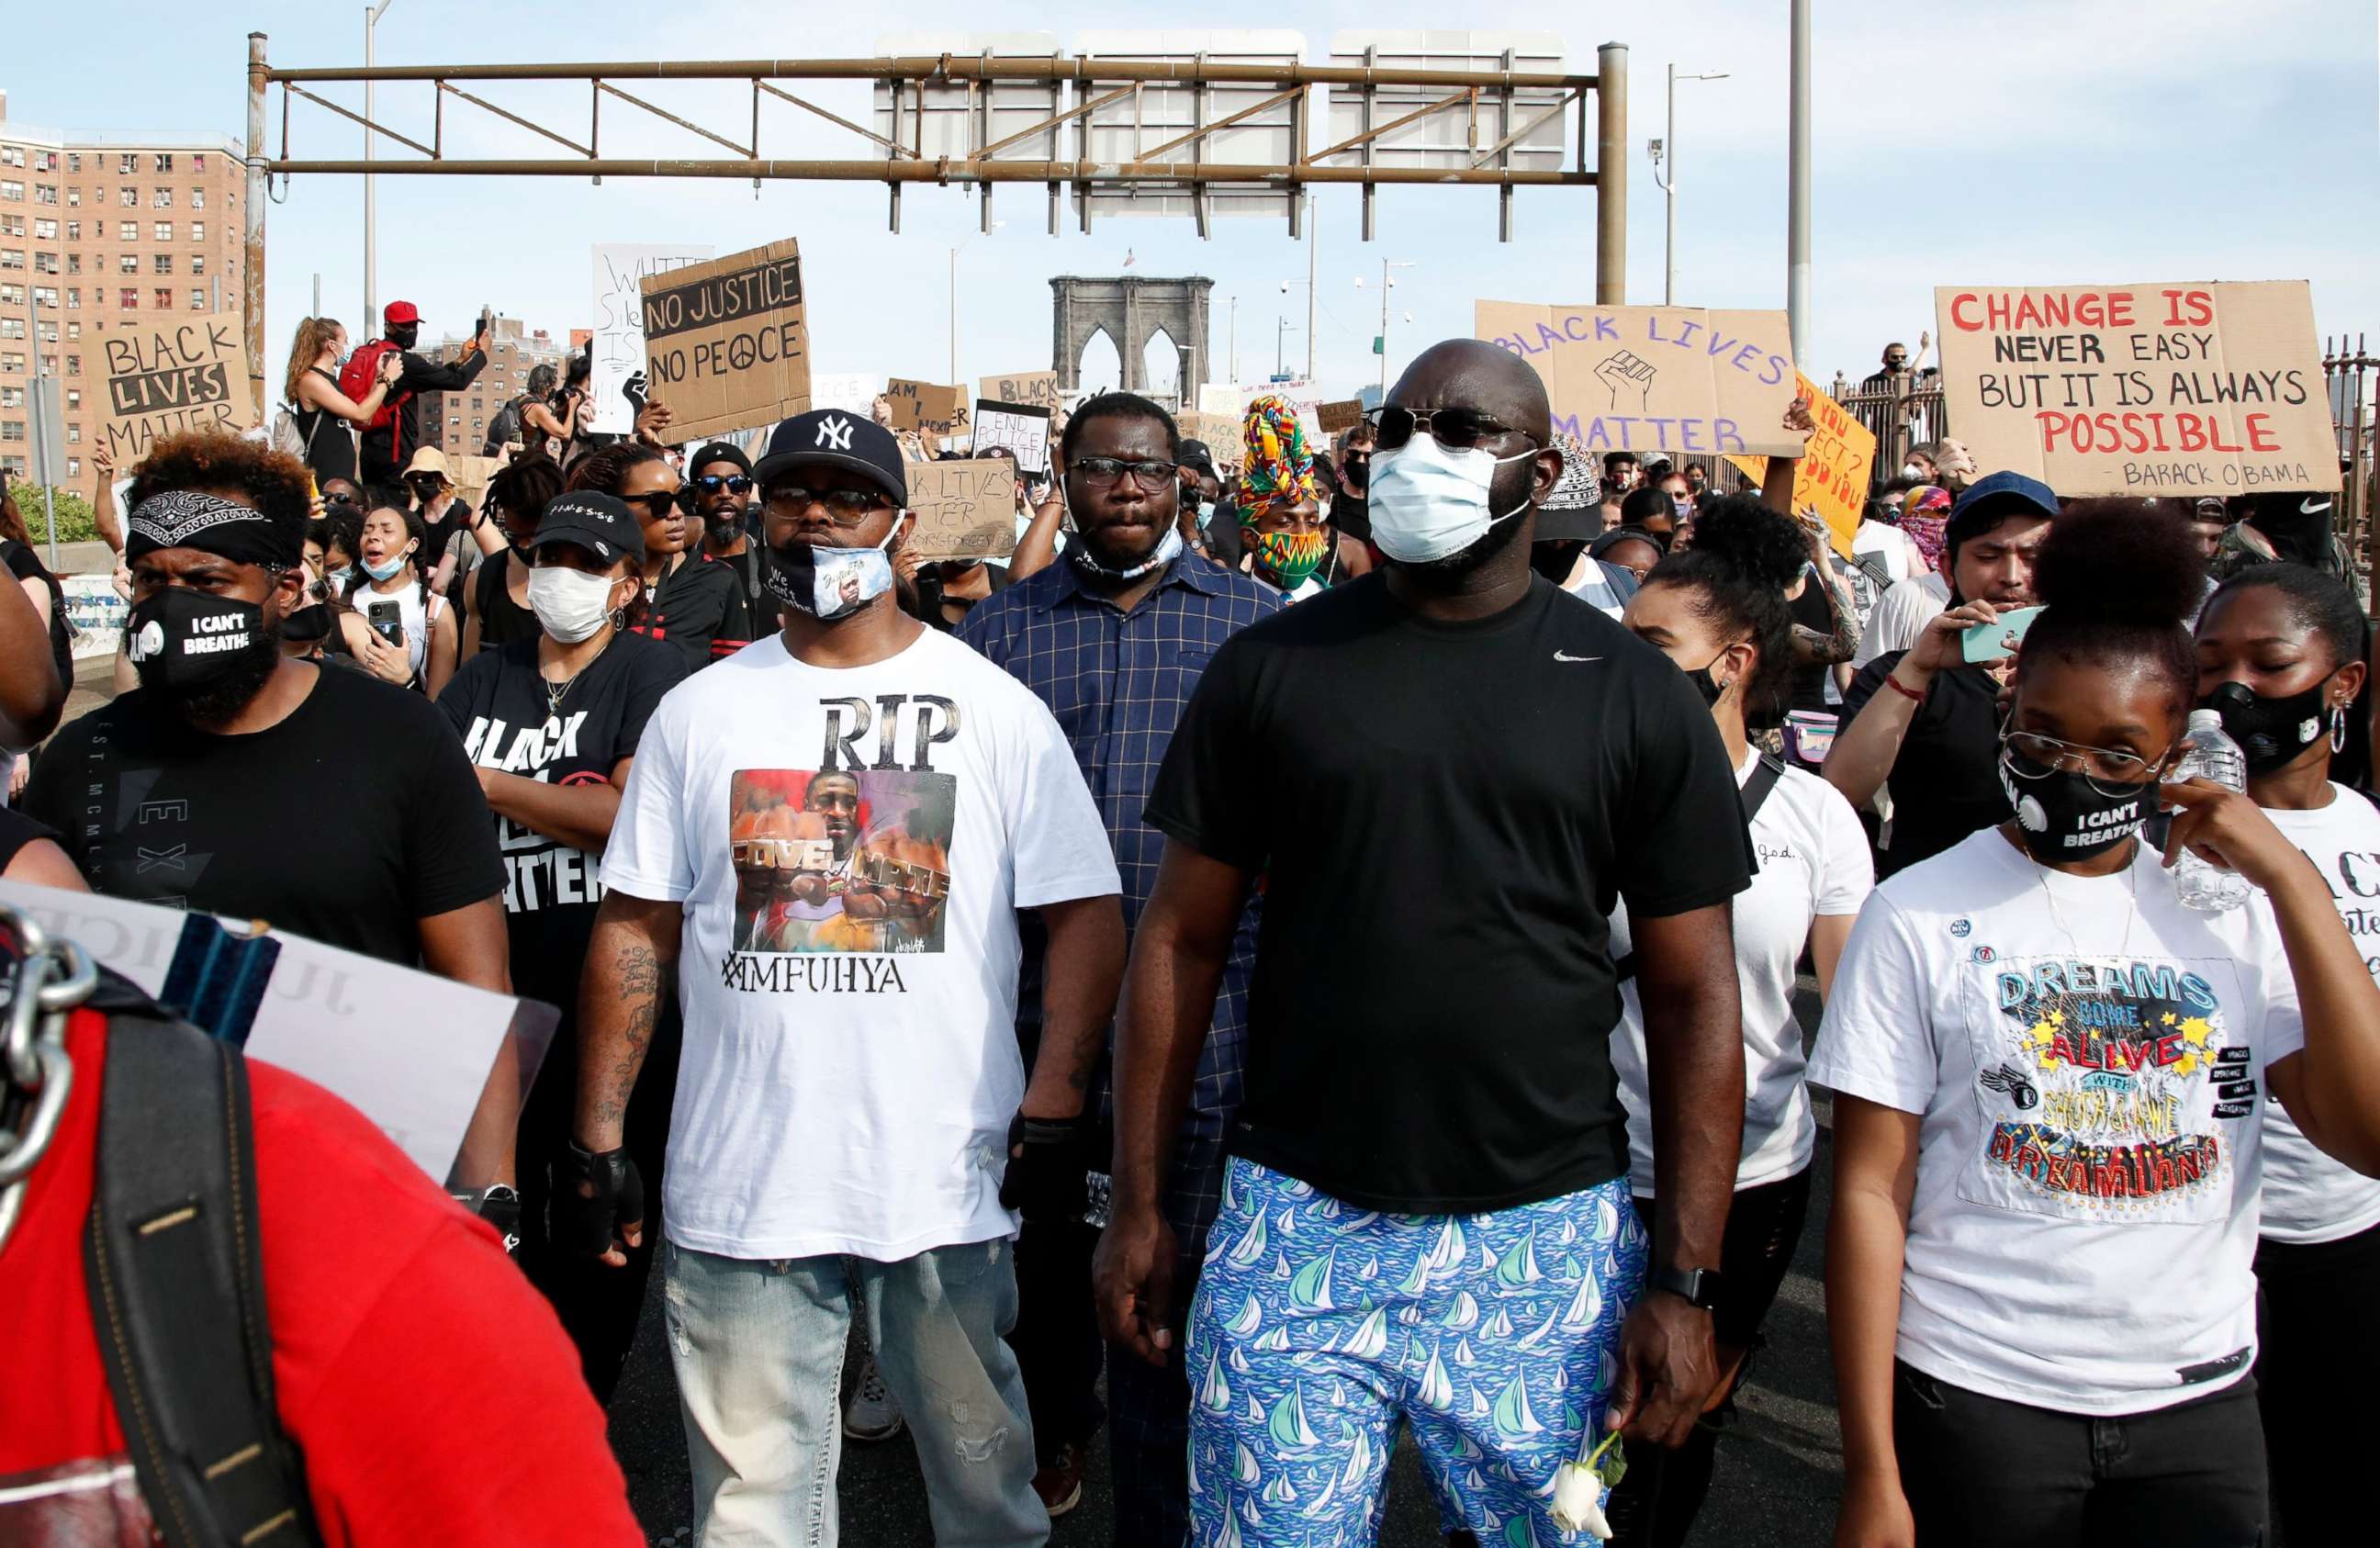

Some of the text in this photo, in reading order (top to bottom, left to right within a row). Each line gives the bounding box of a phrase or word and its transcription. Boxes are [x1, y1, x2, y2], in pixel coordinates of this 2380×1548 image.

[598, 292, 642, 331] Sile
[646, 262, 799, 334] NO JUSTICE
[1951, 289, 2214, 332] CHANGE IS
[105, 321, 237, 376] BLACK
[1493, 316, 1789, 386] BLACK LIVES
[1994, 332, 2214, 364] NEVER EASY
[116, 365, 222, 409] LIVES
[651, 349, 687, 387] NO
[889, 382, 918, 399] AM
[999, 378, 1059, 402] BLACK
[1979, 369, 2307, 409] BUT IT IS ALWAYS
[978, 425, 1041, 448] POLICE
[994, 412, 1028, 432] END
[1550, 413, 1746, 453] MATTER
[2036, 412, 2282, 454] POSSIBLE
[939, 468, 1013, 499] LIVES
[1831, 473, 1861, 510] YOU
[2123, 462, 2212, 487] BARACK
[2222, 462, 2309, 488] OBAMA
[770, 566, 788, 587] We
[192, 612, 245, 634] I CAN'T
[464, 711, 589, 772] BLACK
[819, 693, 961, 771] RIP
[2078, 801, 2139, 831] I CAN'T
[1997, 960, 2218, 1011] DREAMS
[2047, 1032, 2184, 1071] ALIVE
[2091, 1074, 2132, 1090] WITH
[1989, 1127, 2220, 1199] DREAMLAND
